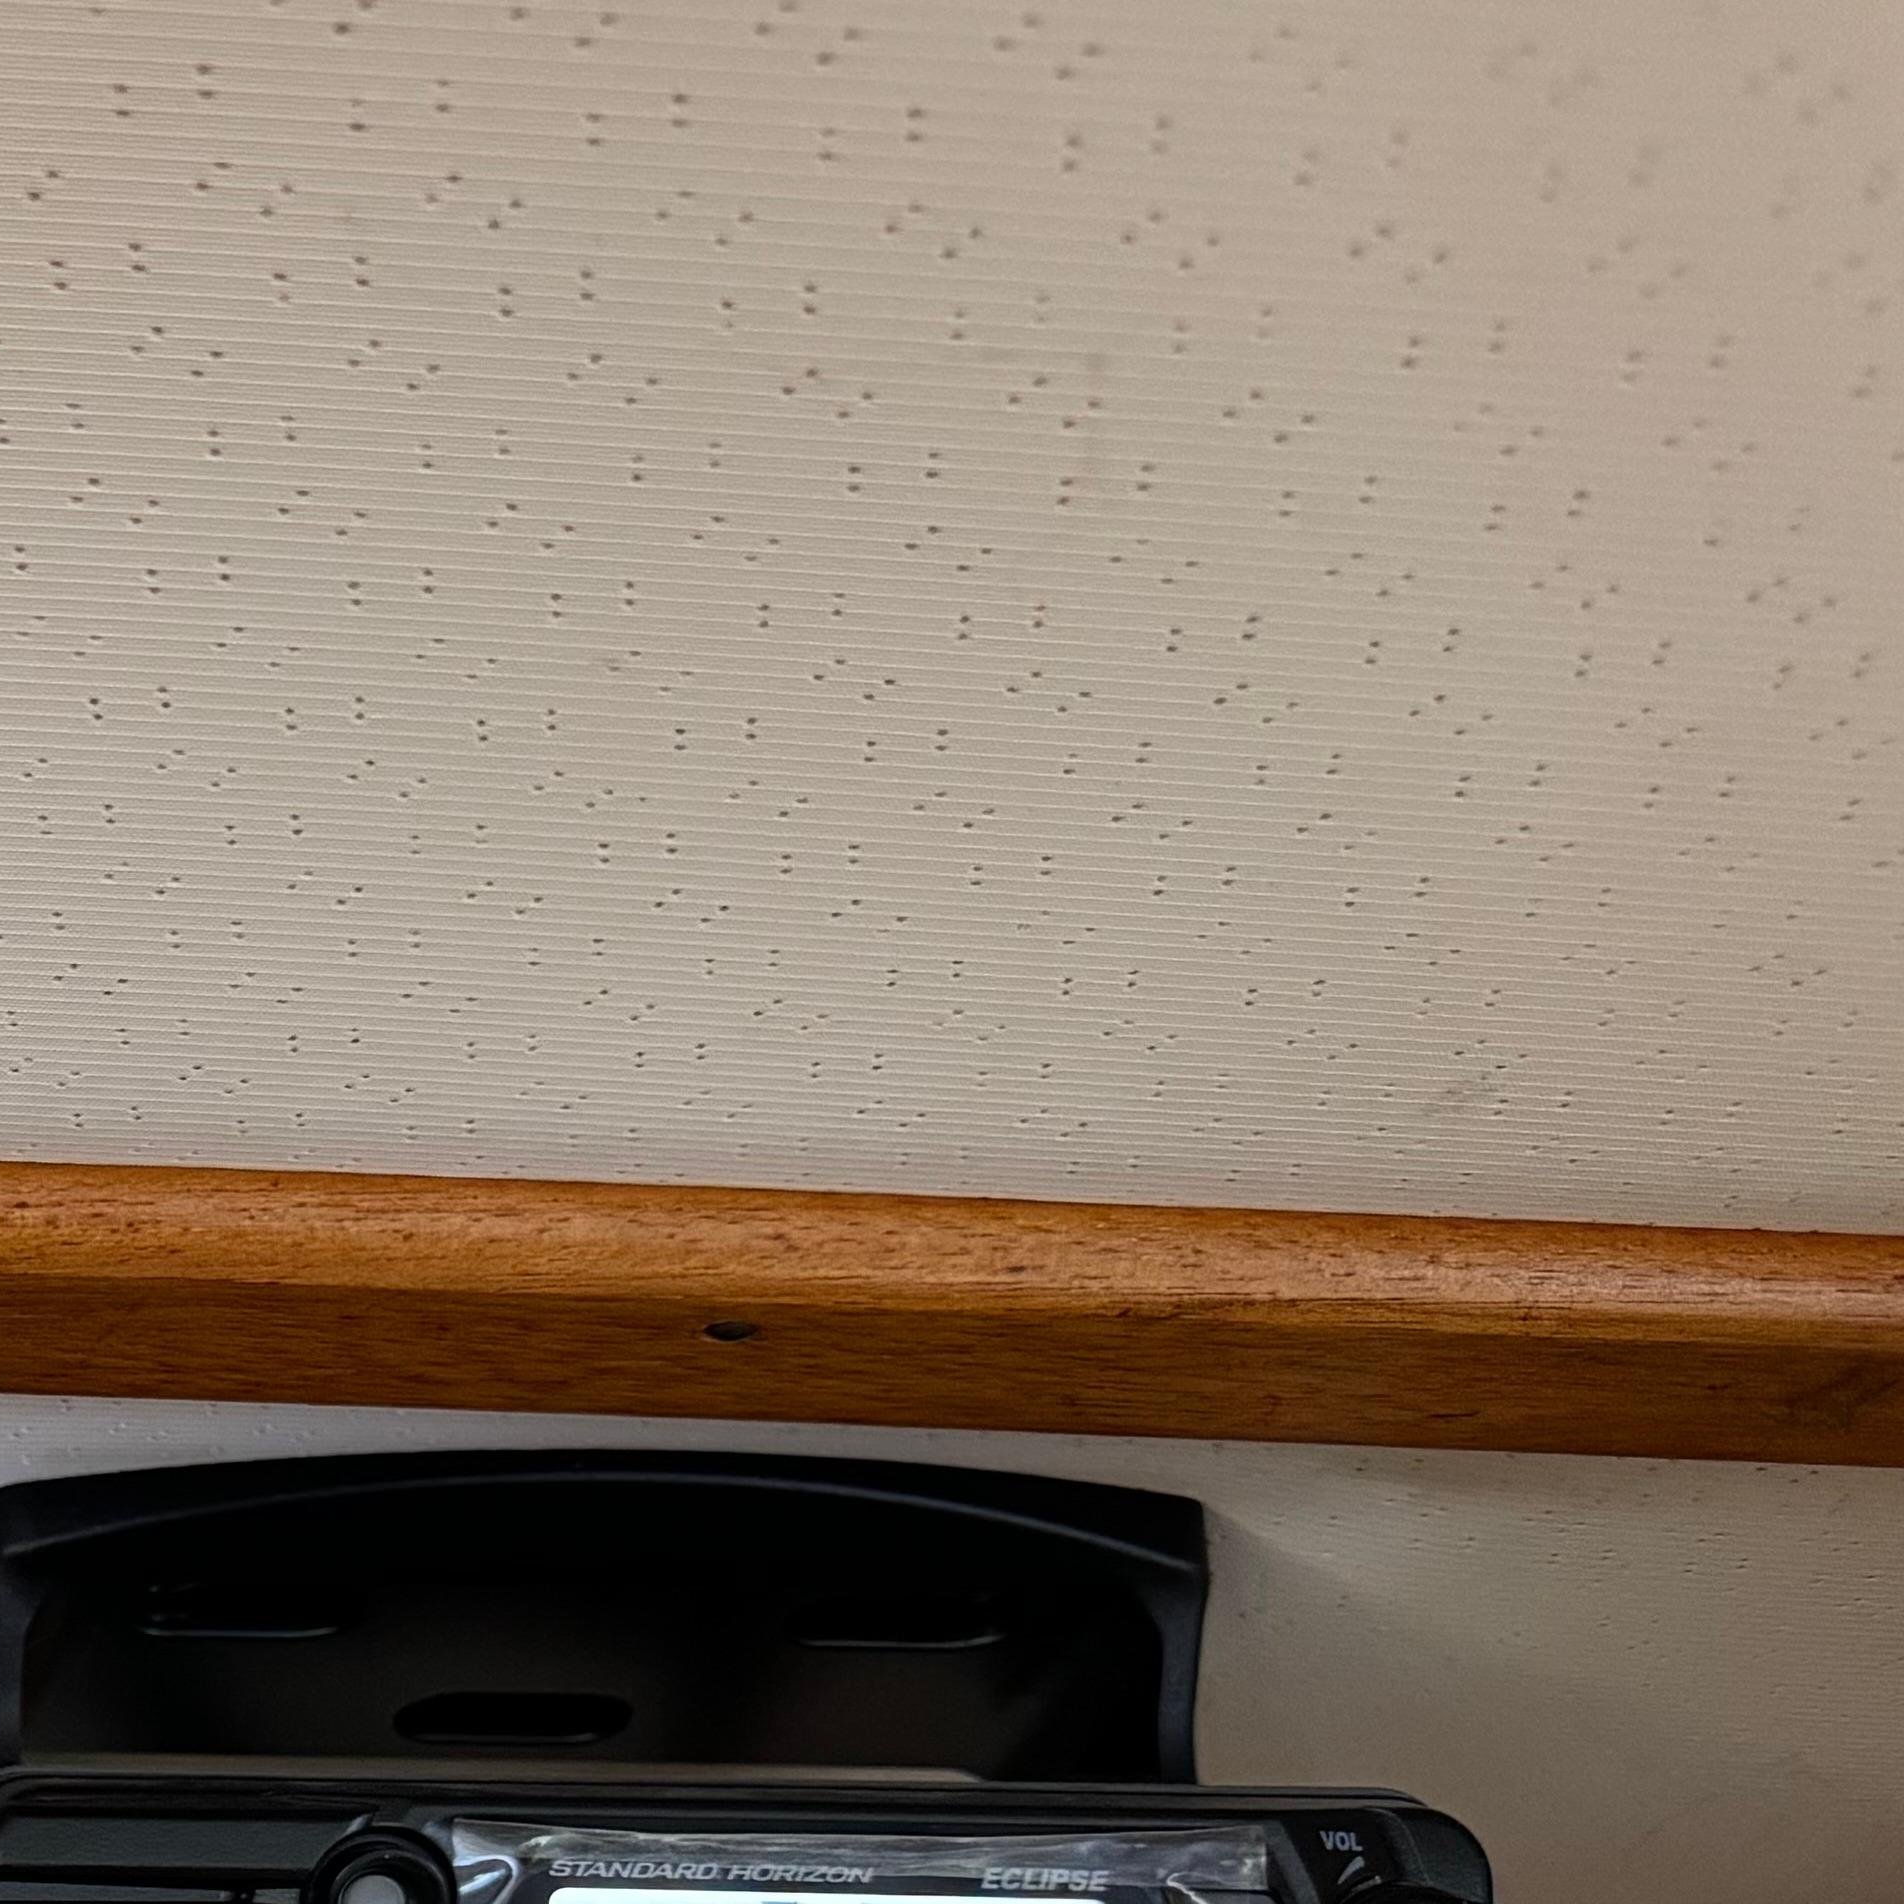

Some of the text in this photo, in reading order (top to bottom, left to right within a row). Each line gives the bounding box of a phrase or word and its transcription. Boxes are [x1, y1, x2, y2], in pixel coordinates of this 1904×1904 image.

[1319, 1830, 1363, 1852] VOL
[548, 1860, 875, 1884] STANDARD HORIZON
[980, 1867, 1111, 1893] ECLIPSE
